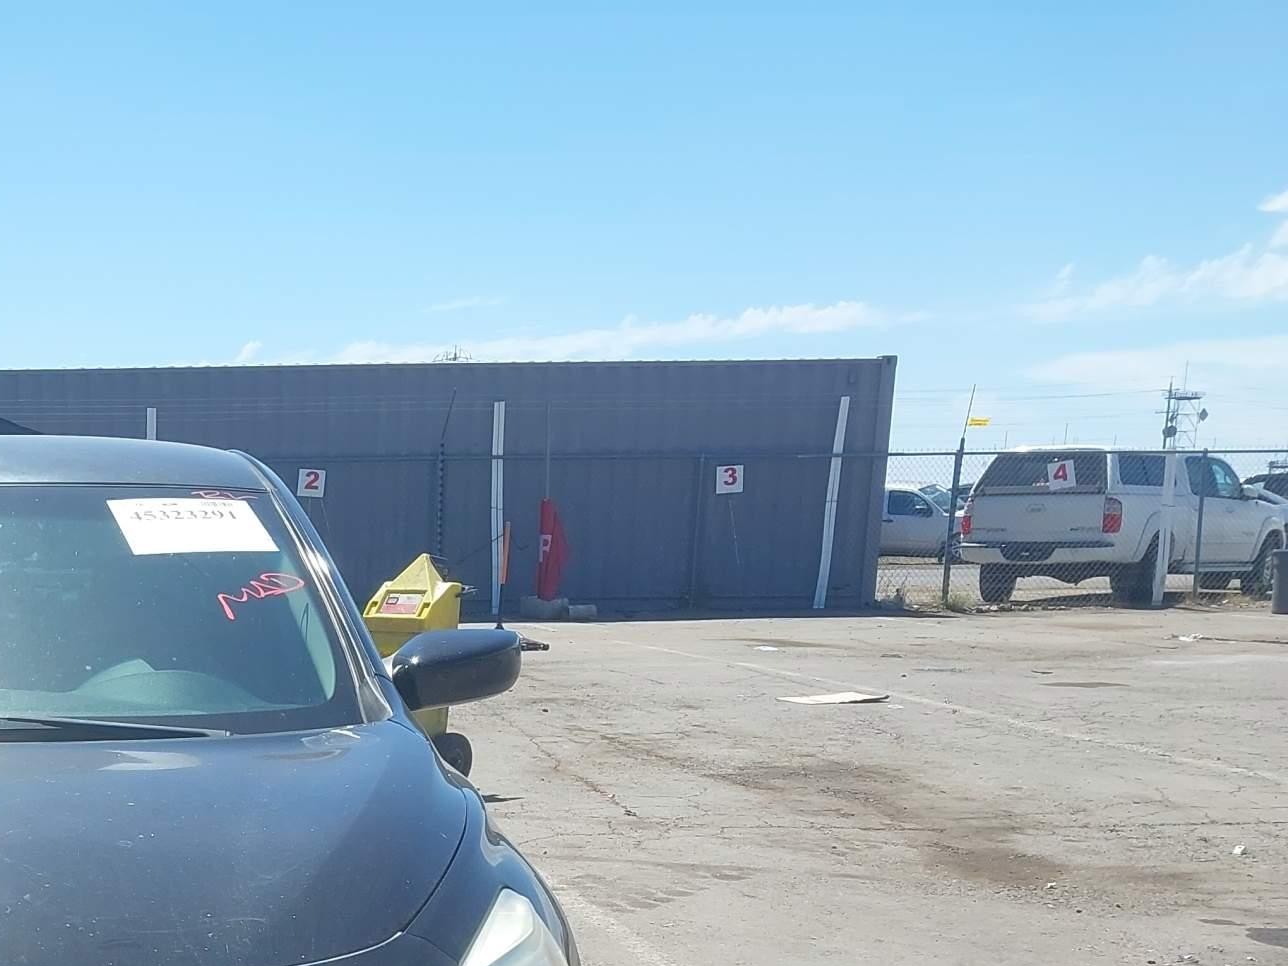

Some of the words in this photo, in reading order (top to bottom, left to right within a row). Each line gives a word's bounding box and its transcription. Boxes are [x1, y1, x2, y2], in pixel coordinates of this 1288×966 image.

[304, 471, 320, 490] 2
[723, 467, 738, 486] 3
[1053, 463, 1068, 481] 4
